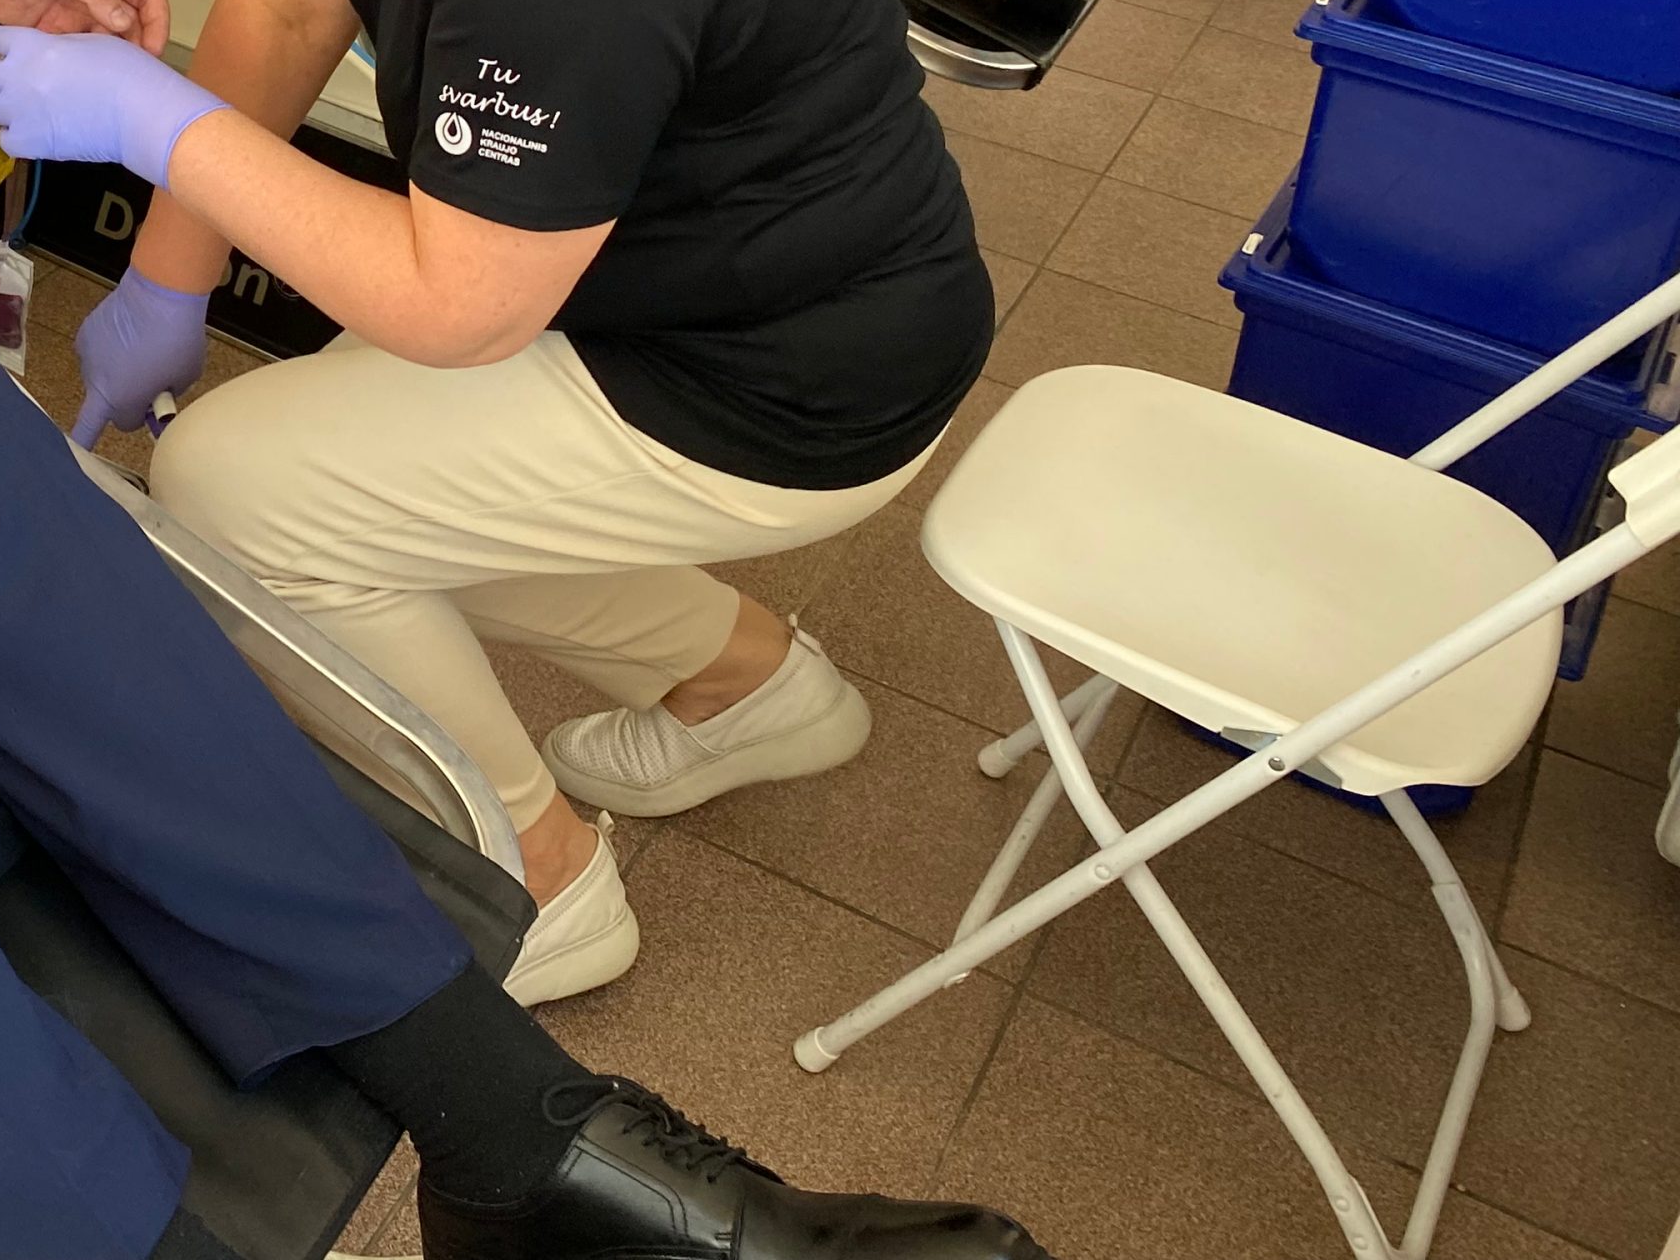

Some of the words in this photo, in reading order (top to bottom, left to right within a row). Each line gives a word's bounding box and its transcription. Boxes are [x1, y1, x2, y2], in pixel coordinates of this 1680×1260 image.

[478, 58, 521, 84] Tu
[479, 138, 518, 155] KRAUJO
[481, 128, 548, 153] NACIONALINIS
[478, 148, 521, 167] CENTRAS
